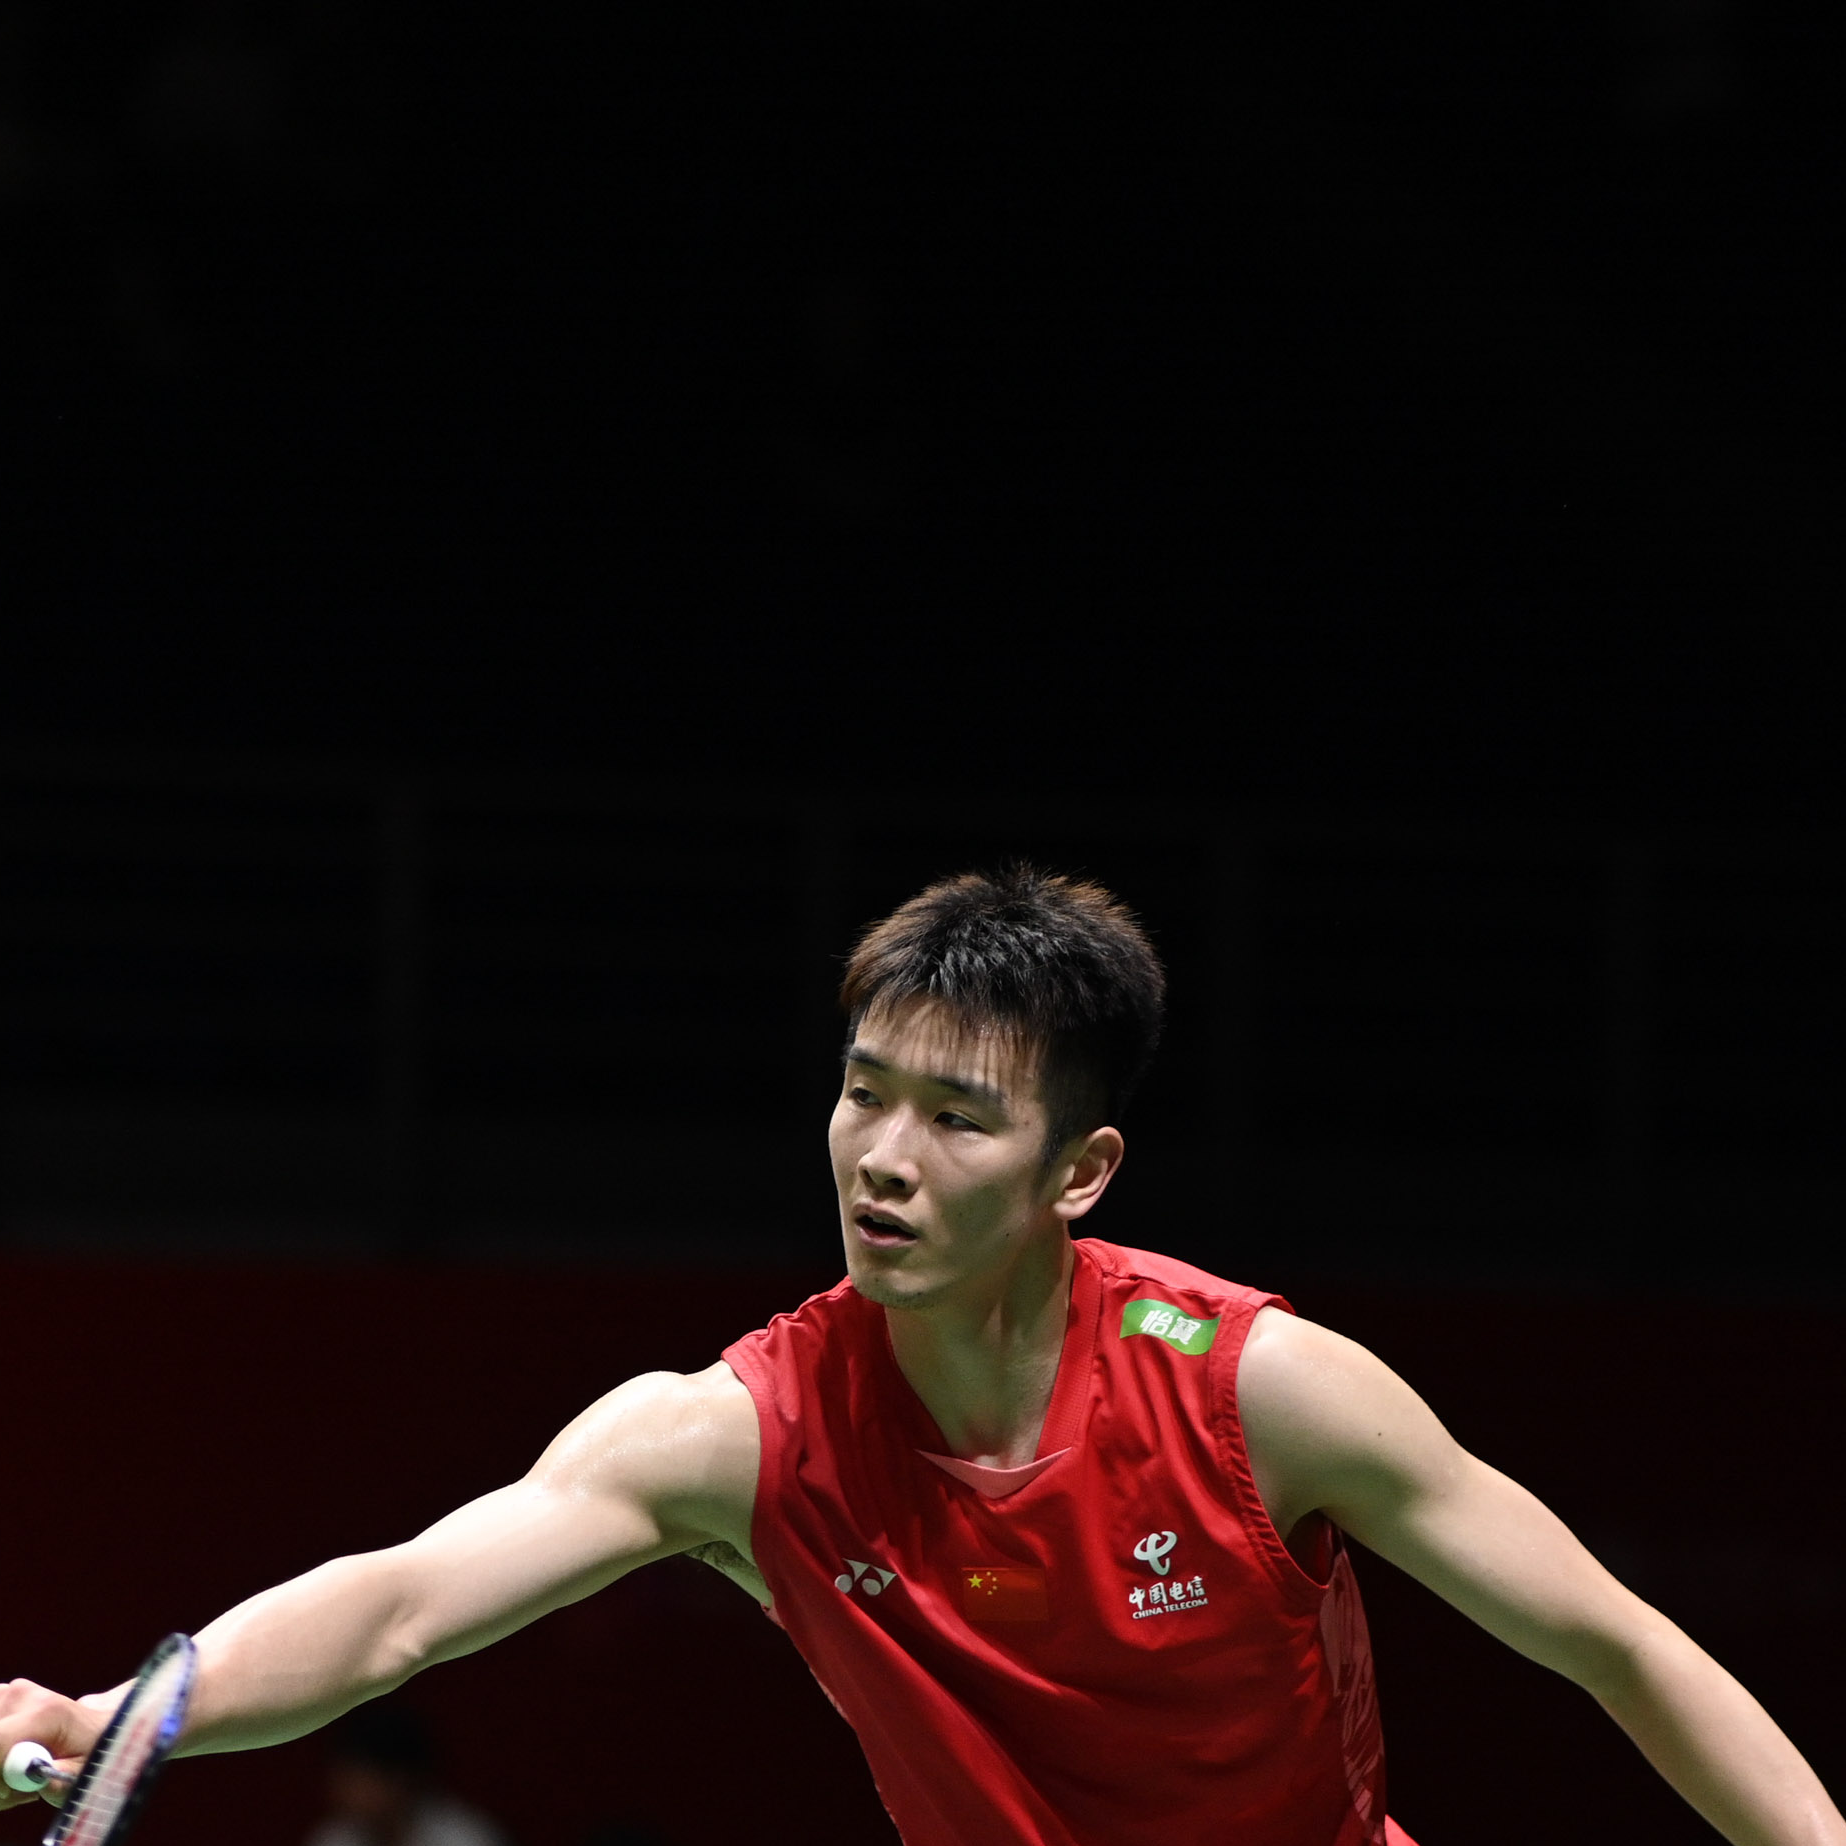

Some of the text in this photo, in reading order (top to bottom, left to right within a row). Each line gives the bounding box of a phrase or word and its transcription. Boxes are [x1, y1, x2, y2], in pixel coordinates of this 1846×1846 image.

[1139, 1309, 1202, 1345] 怡寶
[1129, 1576, 1205, 1610] 中国电信
[1132, 1598, 1208, 1619] CHINA TELECOM
